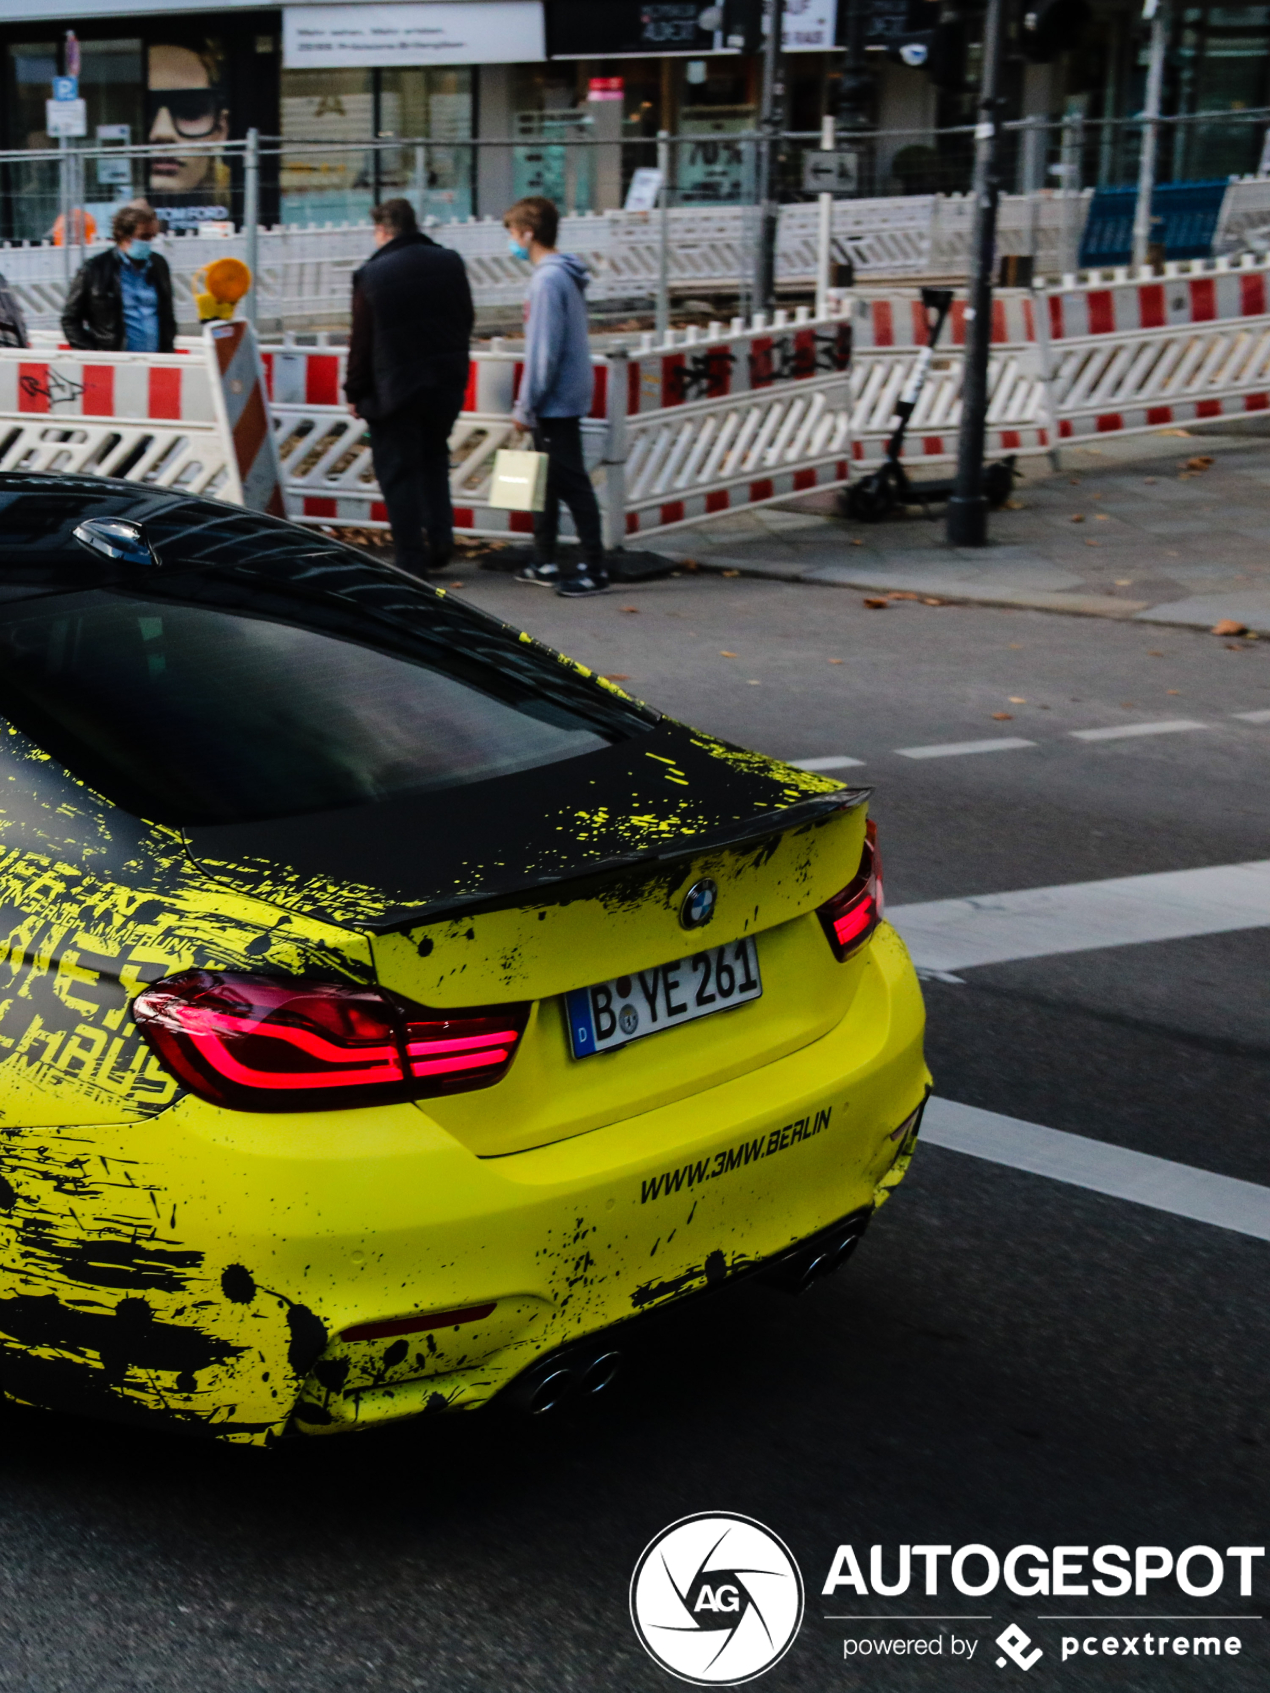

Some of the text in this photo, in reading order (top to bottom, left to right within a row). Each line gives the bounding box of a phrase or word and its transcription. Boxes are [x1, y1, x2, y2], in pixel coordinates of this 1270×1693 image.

[590, 936, 758, 1041] B YE 261
[641, 1106, 832, 1204] WWW.3MW.BERLIN
